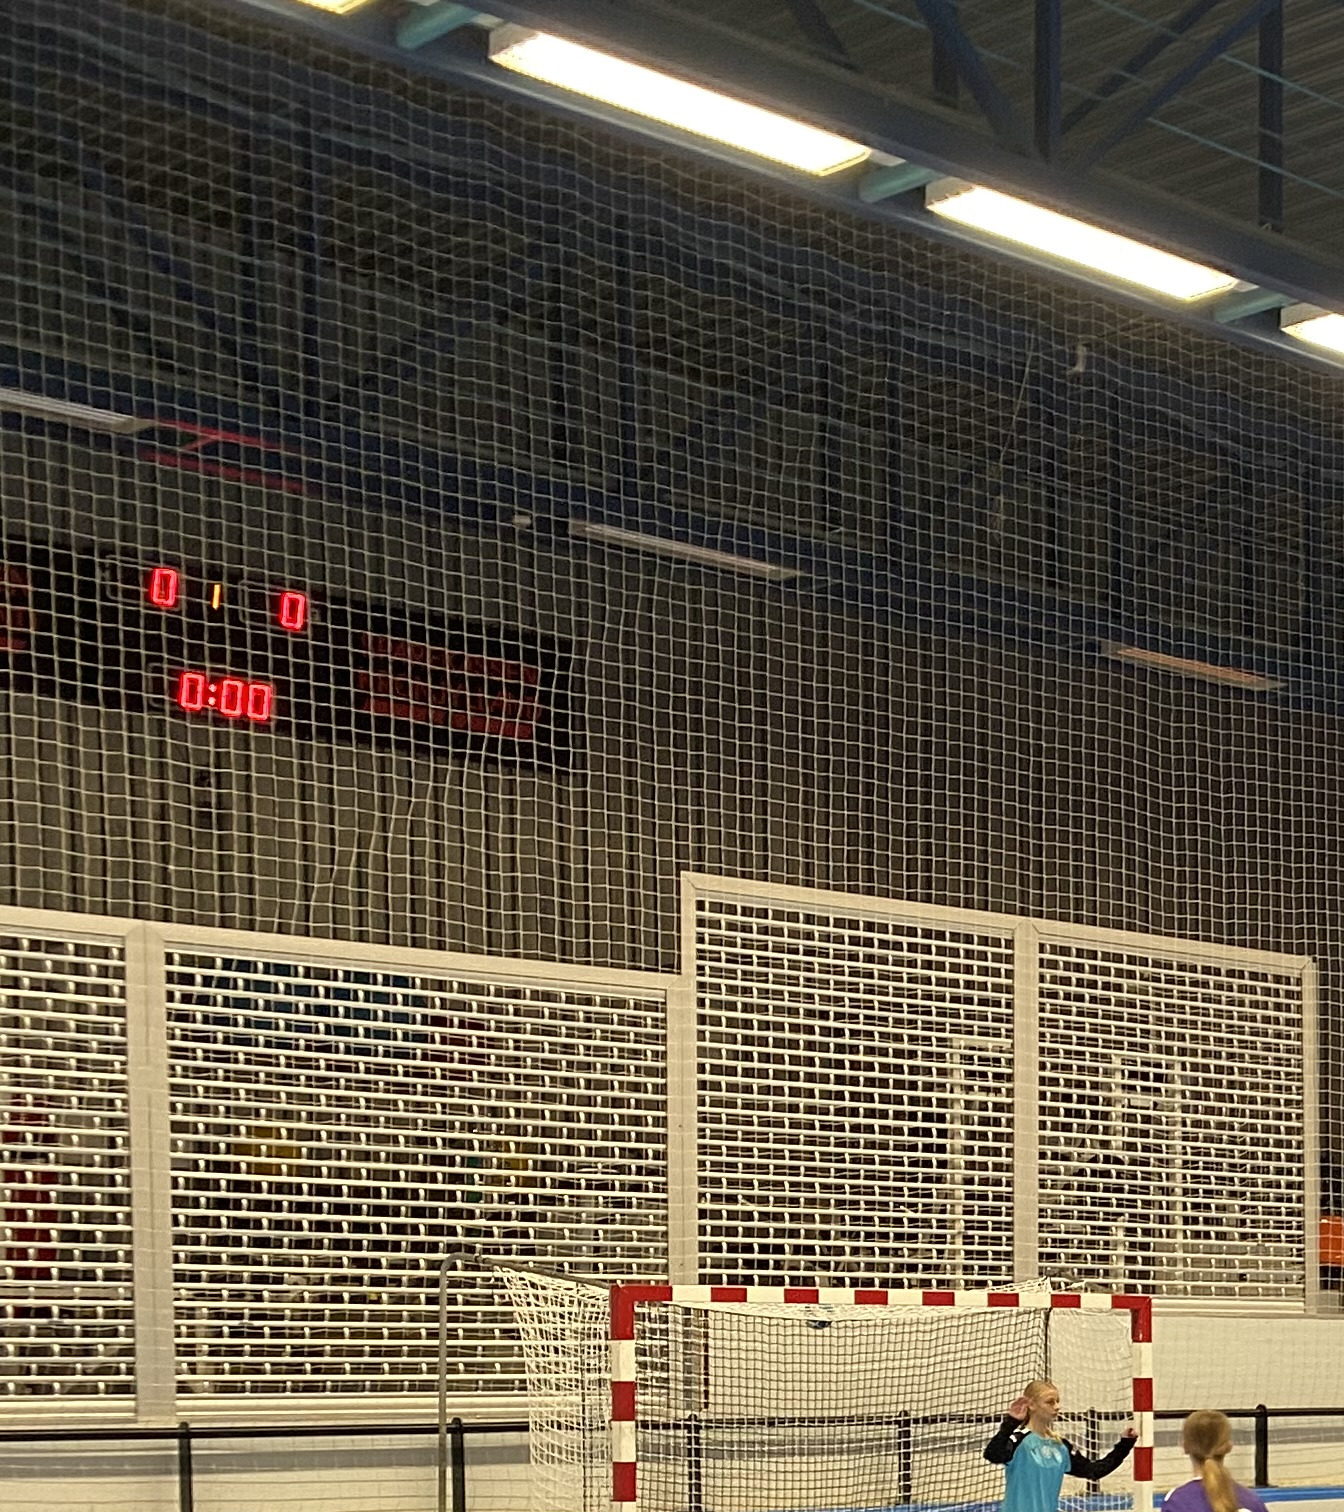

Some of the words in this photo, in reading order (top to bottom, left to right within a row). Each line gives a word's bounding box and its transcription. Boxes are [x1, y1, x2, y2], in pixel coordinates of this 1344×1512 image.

[152, 568, 178, 607] 0
[280, 592, 306, 630] 0
[180, 672, 272, 720] 0:00
